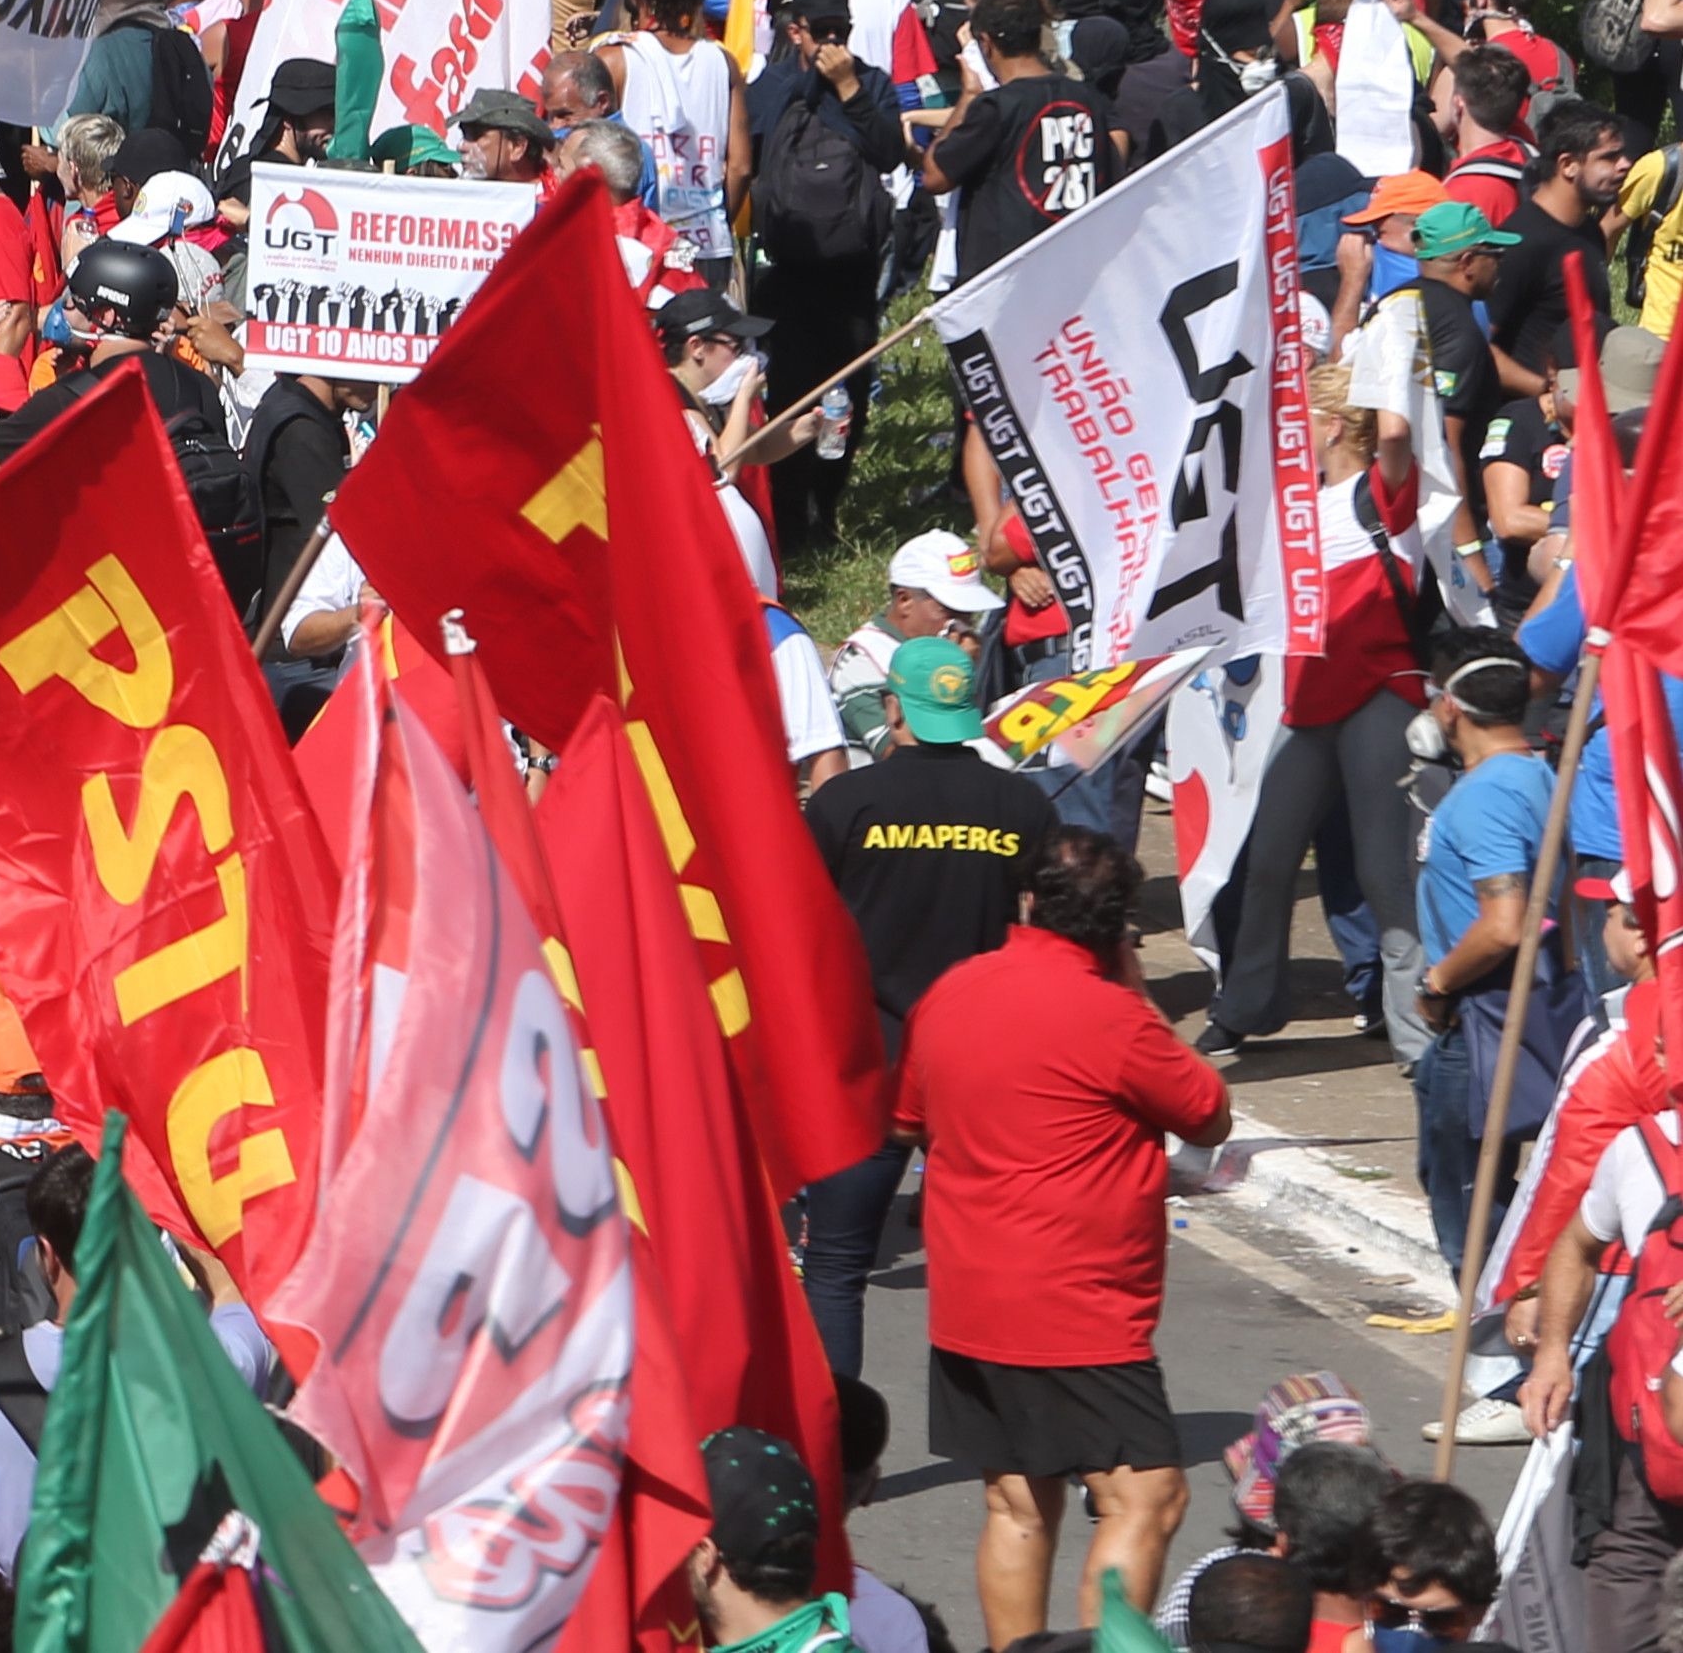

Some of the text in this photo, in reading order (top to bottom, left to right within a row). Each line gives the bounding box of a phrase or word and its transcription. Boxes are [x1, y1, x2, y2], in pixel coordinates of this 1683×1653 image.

[1040, 112, 1094, 163] PEC
[1043, 162, 1096, 213] 287
[264, 226, 339, 256] UGT
[350, 210, 517, 252] REFORMAS?
[348, 246, 403, 265] NENHUM
[406, 252, 459, 269] DIREITO
[461, 257, 470, 271] A
[472, 257, 501, 273] MEN
[264, 324, 312, 353] UGT
[314, 328, 343, 356] 10
[345, 330, 408, 361] ANOS
[1061, 314, 1137, 438] UNIÃO
[1266, 167, 1320, 642] UGT UGT UGT UGT UGT UGT
[1147, 259, 1256, 623] UGT
[962, 353, 1092, 674] UGT UGT UGT UGT UG
